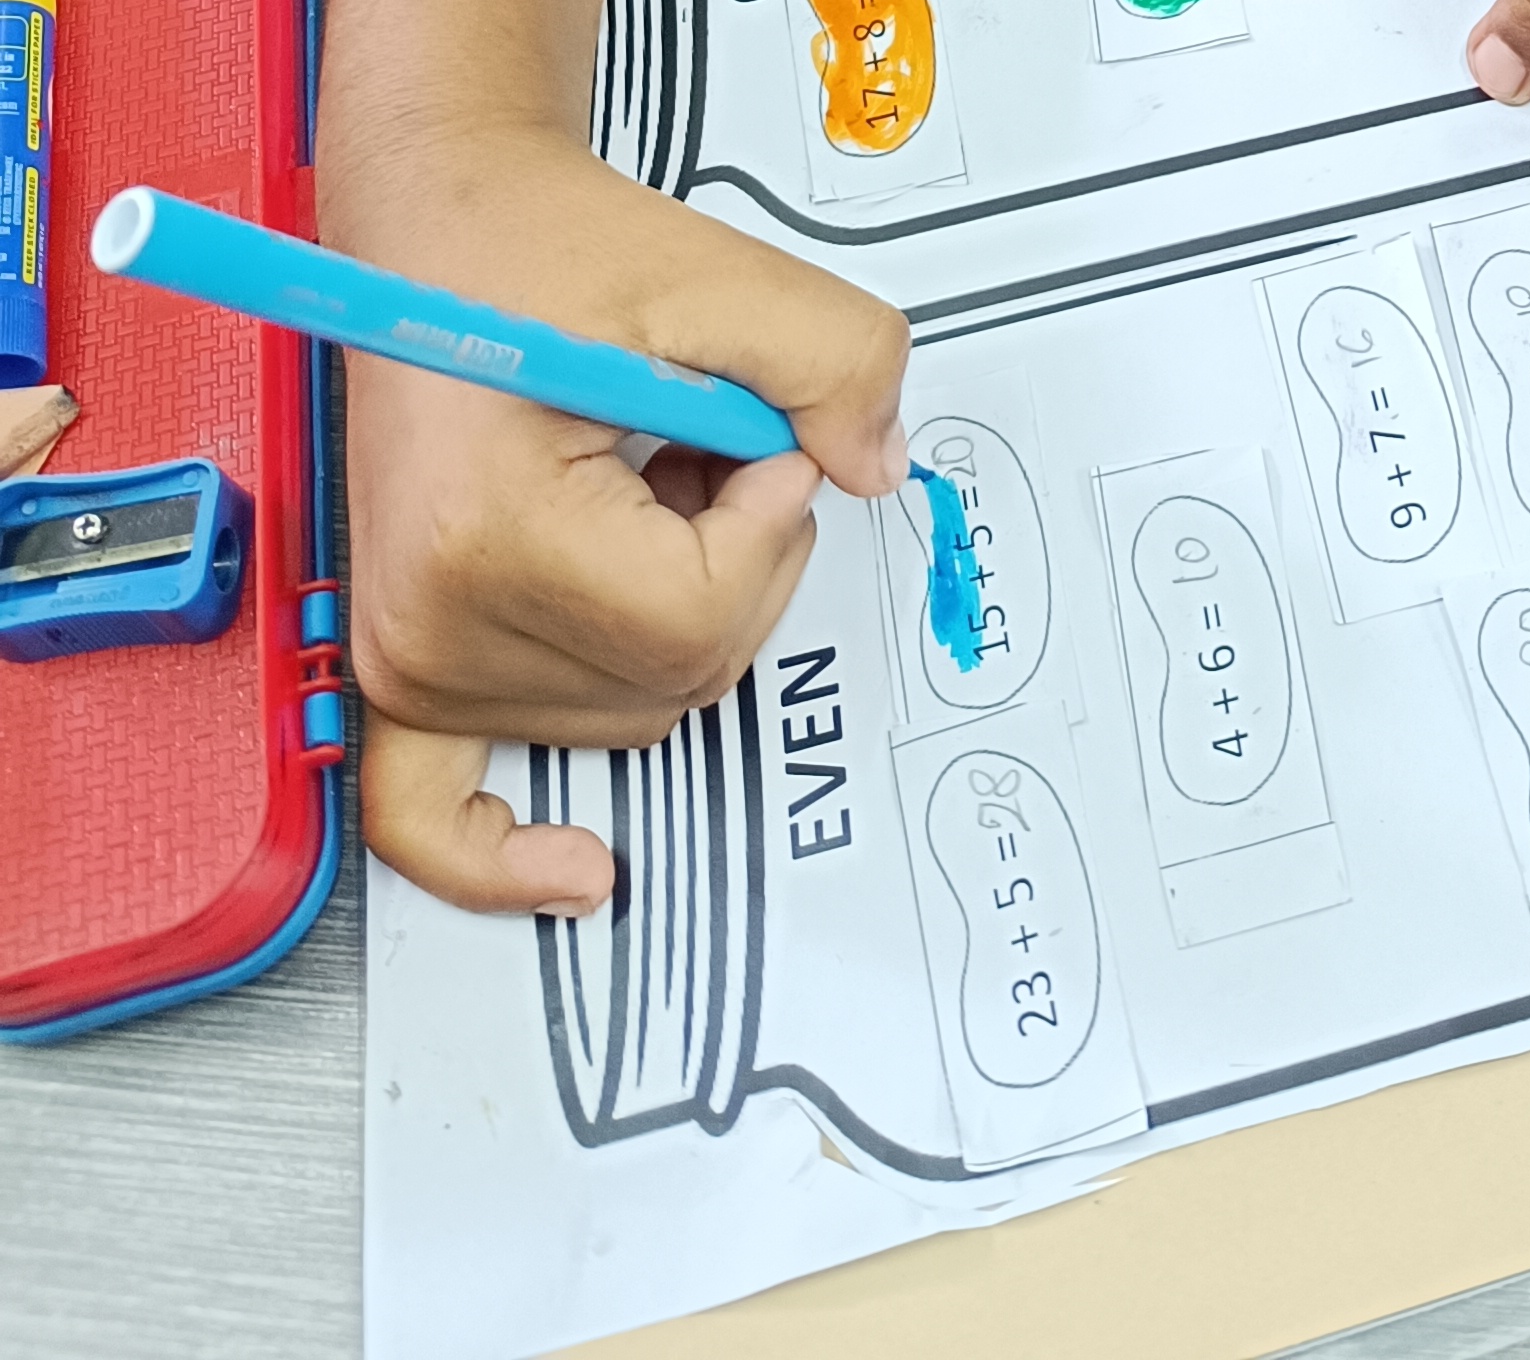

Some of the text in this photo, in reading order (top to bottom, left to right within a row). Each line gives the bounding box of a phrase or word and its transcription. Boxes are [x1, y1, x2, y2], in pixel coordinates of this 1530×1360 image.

[33, 17, 42, 50] PAPER
[853, 19, 886, 42] 8
[31, 50, 41, 95] STICKING
[32, 96, 40, 115] FOR
[862, 88, 900, 129] 17
[26, 176, 37, 275] KEEP STICK CLOSED
[931, 435, 977, 481] 20
[1369, 431, 1406, 453] 7
[1390, 502, 1427, 529] 9
[953, 524, 993, 551] 5
[1172, 536, 1219, 584] 10
[967, 605, 1011, 661] 15
[1198, 644, 1236, 672] 6
[777, 645, 852, 861] EVEN
[1212, 729, 1249, 757] 4
[968, 768, 1032, 832] 28
[993, 877, 1034, 909] 5
[1011, 970, 1058, 1037] 23
